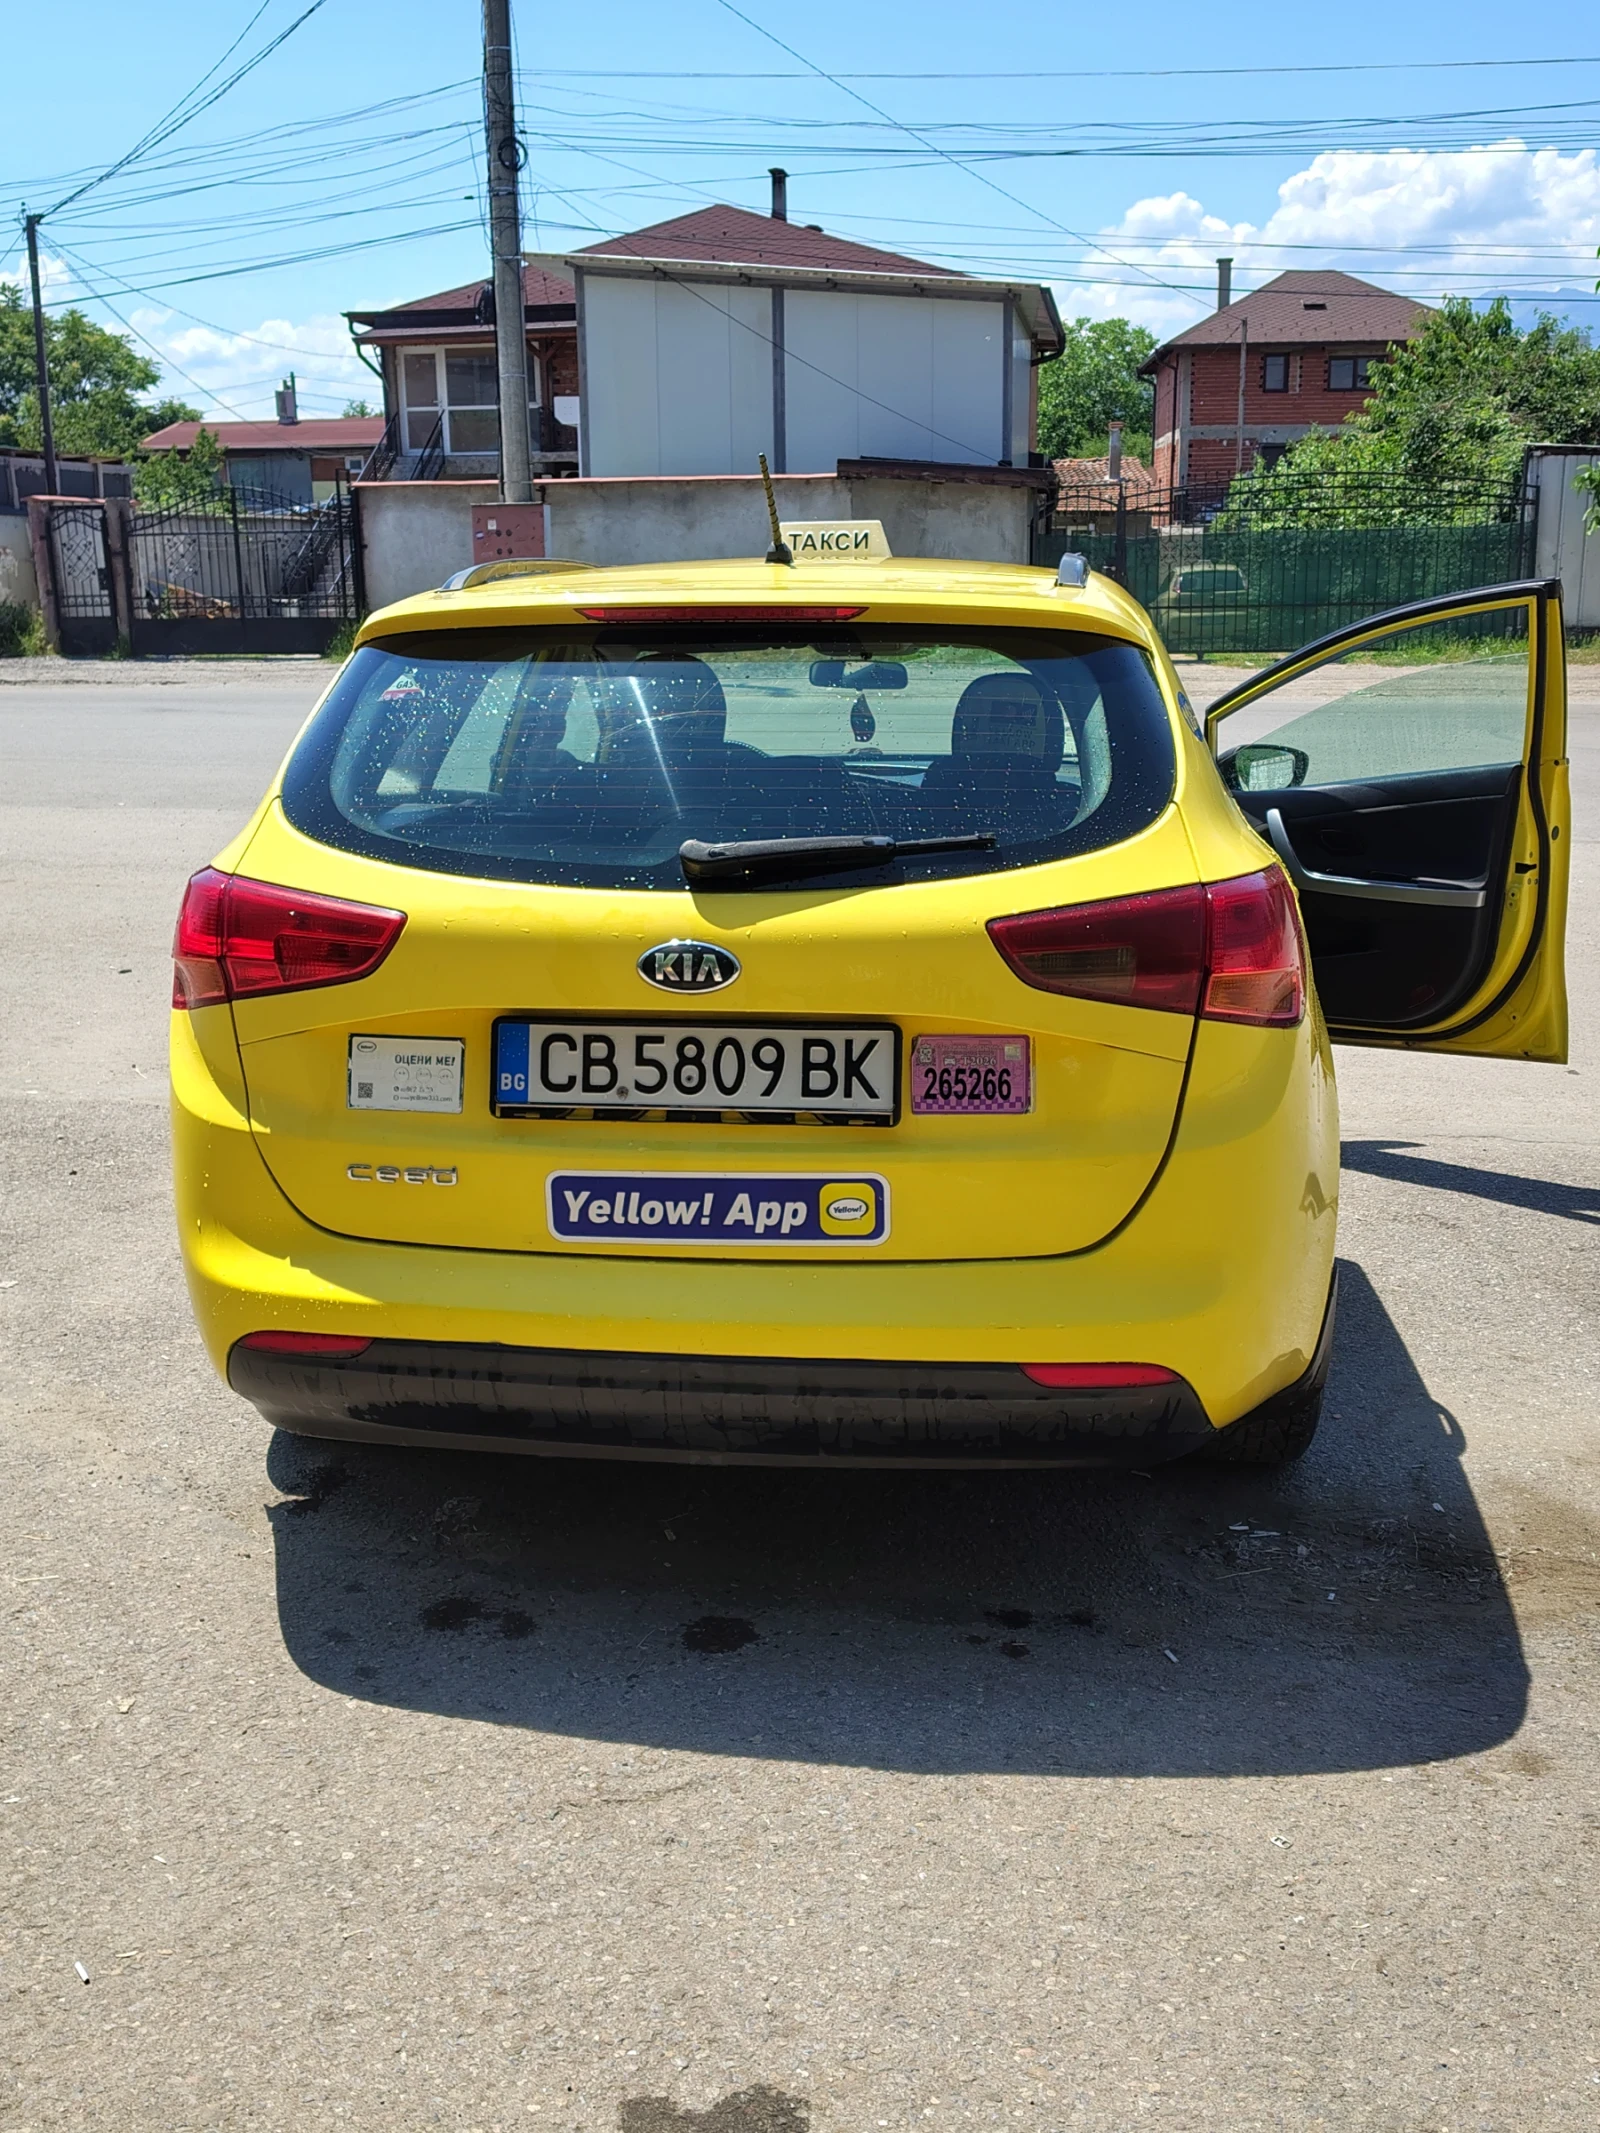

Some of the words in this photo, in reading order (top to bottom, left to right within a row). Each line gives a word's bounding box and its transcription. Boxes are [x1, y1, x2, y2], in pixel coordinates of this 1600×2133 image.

[788, 531, 869, 551] ТАКСИ
[396, 680, 413, 689] GAS
[655, 952, 723, 982] KIA
[394, 1054, 432, 1067] ОЦЕНИ
[435, 1055, 456, 1067] МЕ!
[500, 1072, 526, 1091] BG
[924, 1067, 1012, 1101] 265266
[563, 1190, 715, 1226] Yellow!
[723, 1192, 808, 1234] App
[833, 1204, 863, 1214] Yellow!
